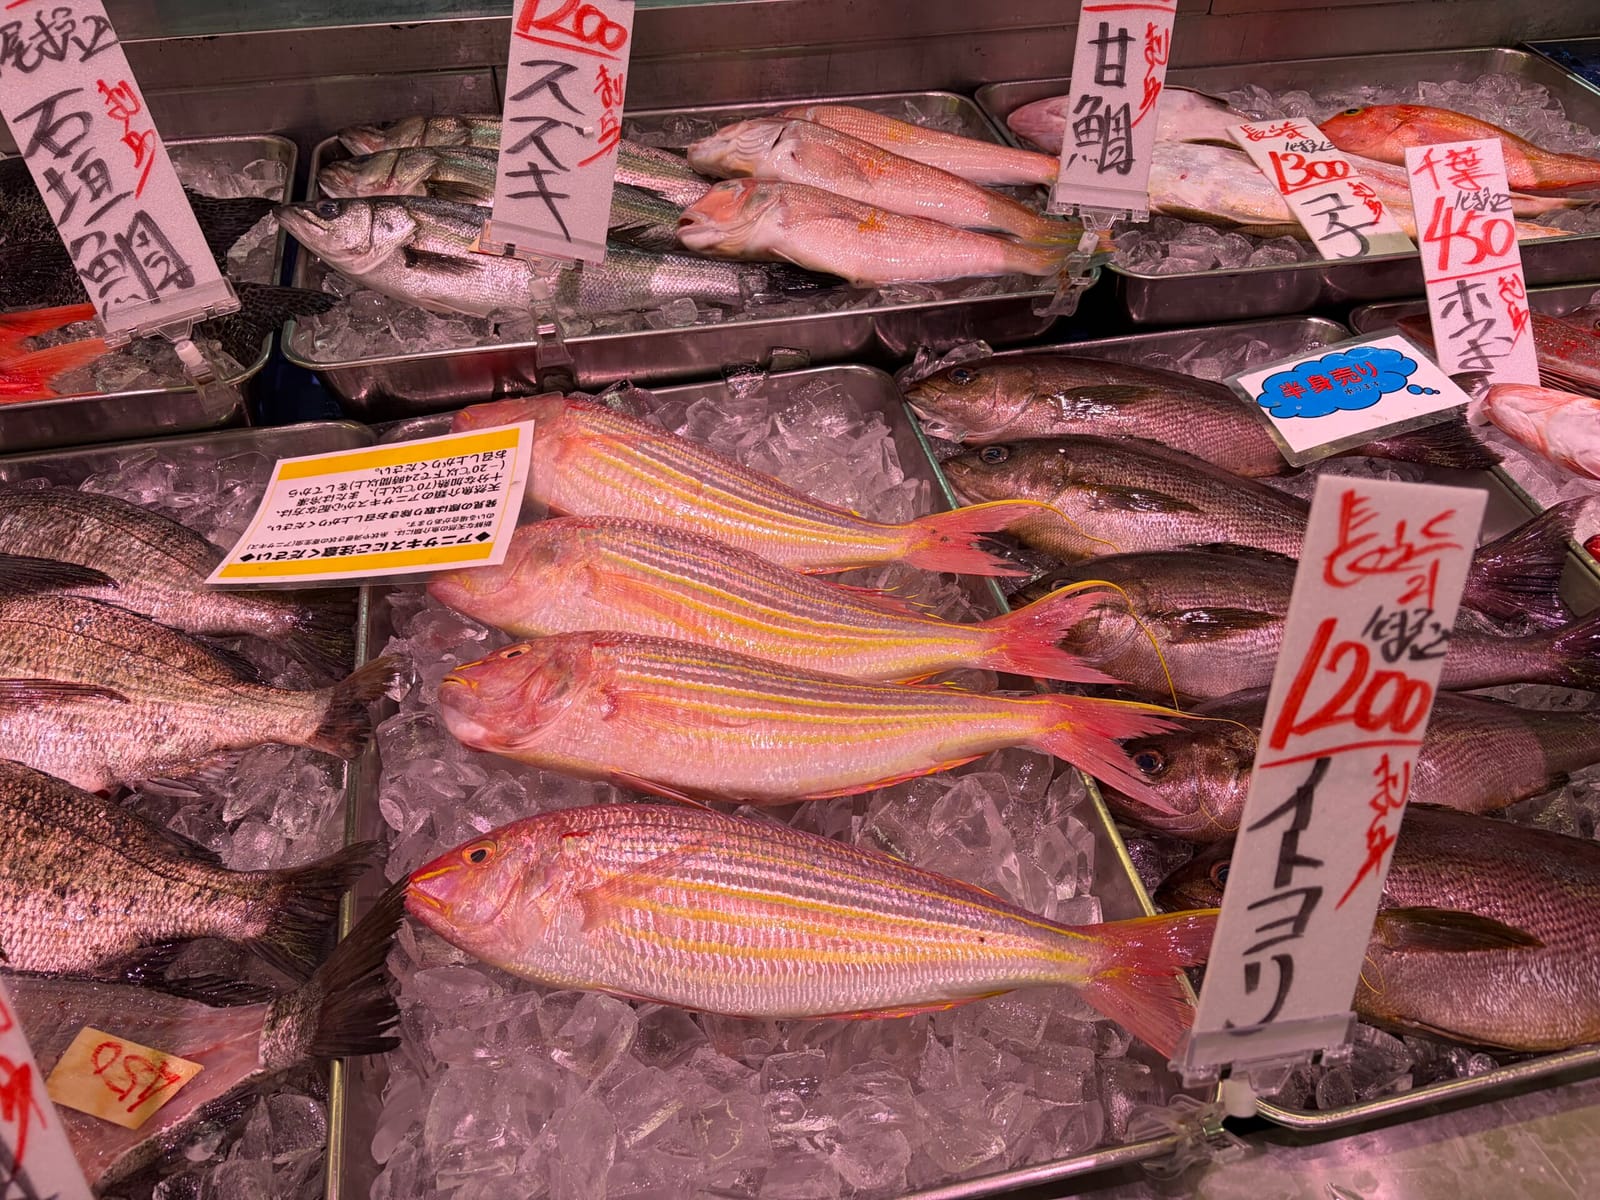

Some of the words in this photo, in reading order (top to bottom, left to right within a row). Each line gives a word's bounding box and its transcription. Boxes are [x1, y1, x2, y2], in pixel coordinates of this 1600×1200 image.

[1067, 22, 1136, 175] 甘鯛
[1268, 151, 1350, 195] 1300
[1412, 147, 1499, 190] 千葉
[13, 88, 195, 322] 石垣鯛
[1424, 196, 1515, 270] 450
[1278, 361, 1379, 399] 半身売り
[374, 450, 507, 475] お召し上がりください。
[267, 499, 497, 531] 発見の際は取り除きお召し上がりください。
[277, 482, 501, 517] 天然魚介類のアニサキスが心配な方は、
[256, 533, 473, 560] アニサキスにご注意ください
[1269, 617, 1433, 750] 1200
[1223, 757, 1332, 1036] イトヨリ
[90, 1041, 181, 1113] 450
